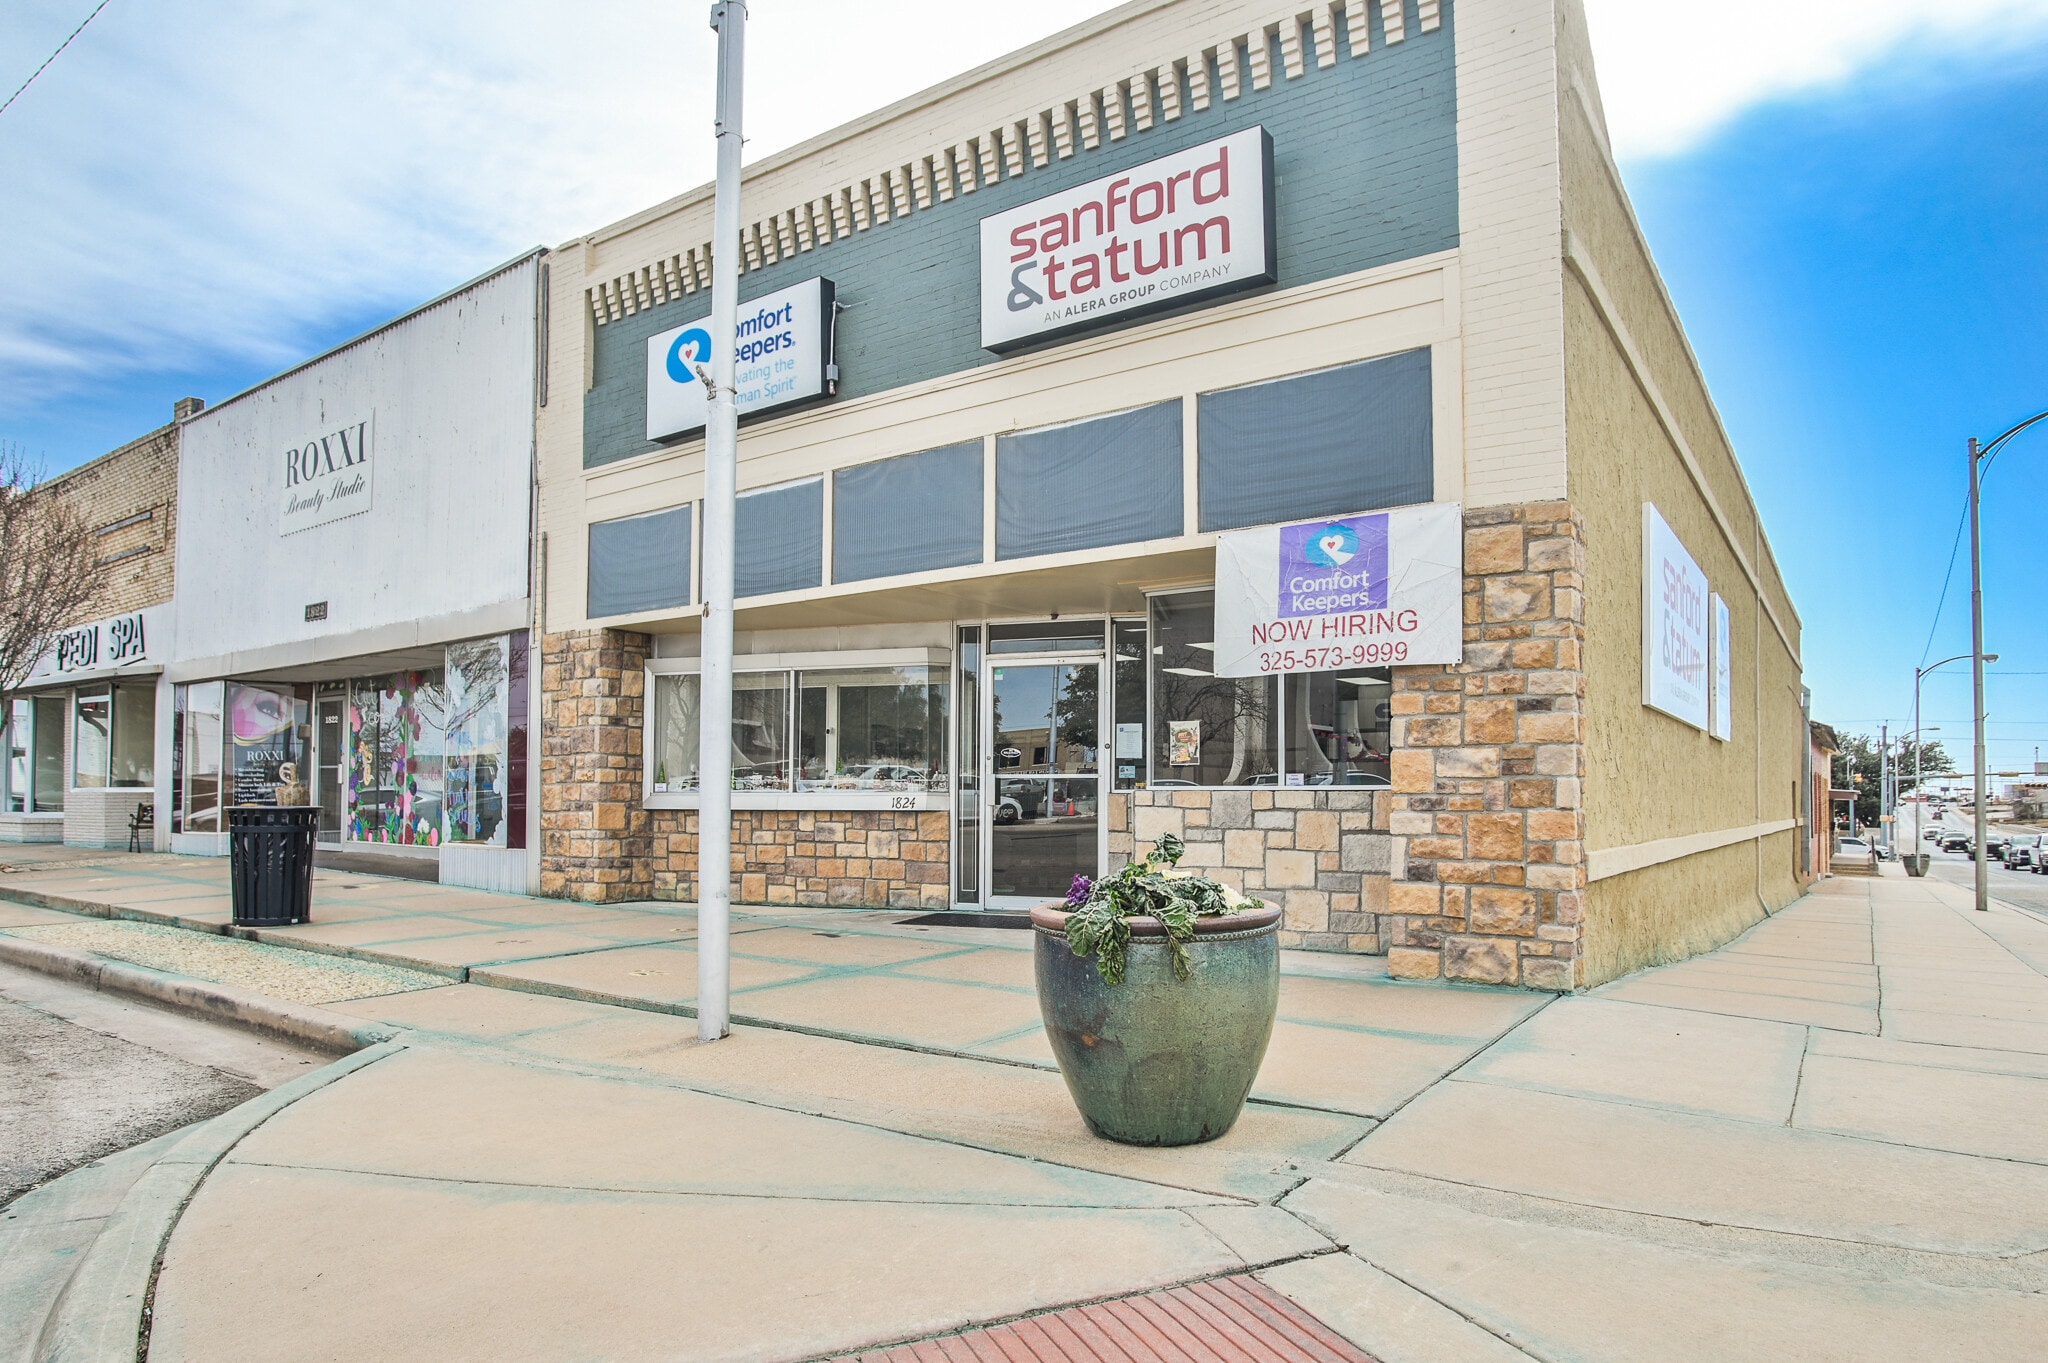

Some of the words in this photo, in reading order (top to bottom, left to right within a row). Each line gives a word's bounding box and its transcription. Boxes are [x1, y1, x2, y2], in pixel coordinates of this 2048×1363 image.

[1010, 145, 1229, 263] sanford
[1044, 309, 1061, 323] AN
[1064, 297, 1106, 318] ALERA
[1109, 283, 1156, 305] GROUP
[1159, 263, 1232, 291] COMPANY
[736, 302, 792, 338] mfort
[736, 365, 771, 384] vating
[774, 358, 795, 374] the
[736, 388, 761, 405] man
[764, 377, 795, 399] Spirit
[285, 421, 367, 489] ROXXI
[284, 489, 324, 516] Beauty
[327, 473, 366, 502] Studio
[1290, 570, 1370, 594] Comfort
[1663, 557, 1701, 636] sanford
[1292, 591, 1369, 613] Keepers
[57, 626, 98, 672] PEDI
[109, 614, 145, 660] SPA
[1252, 619, 1313, 646] NOW
[1322, 609, 1419, 639] HIRING
[1260, 641, 1409, 672] 325-573-9999
[325, 715, 339, 724] 1822
[247, 750, 284, 762] ROXXI
[892, 796, 916, 809] 1824
